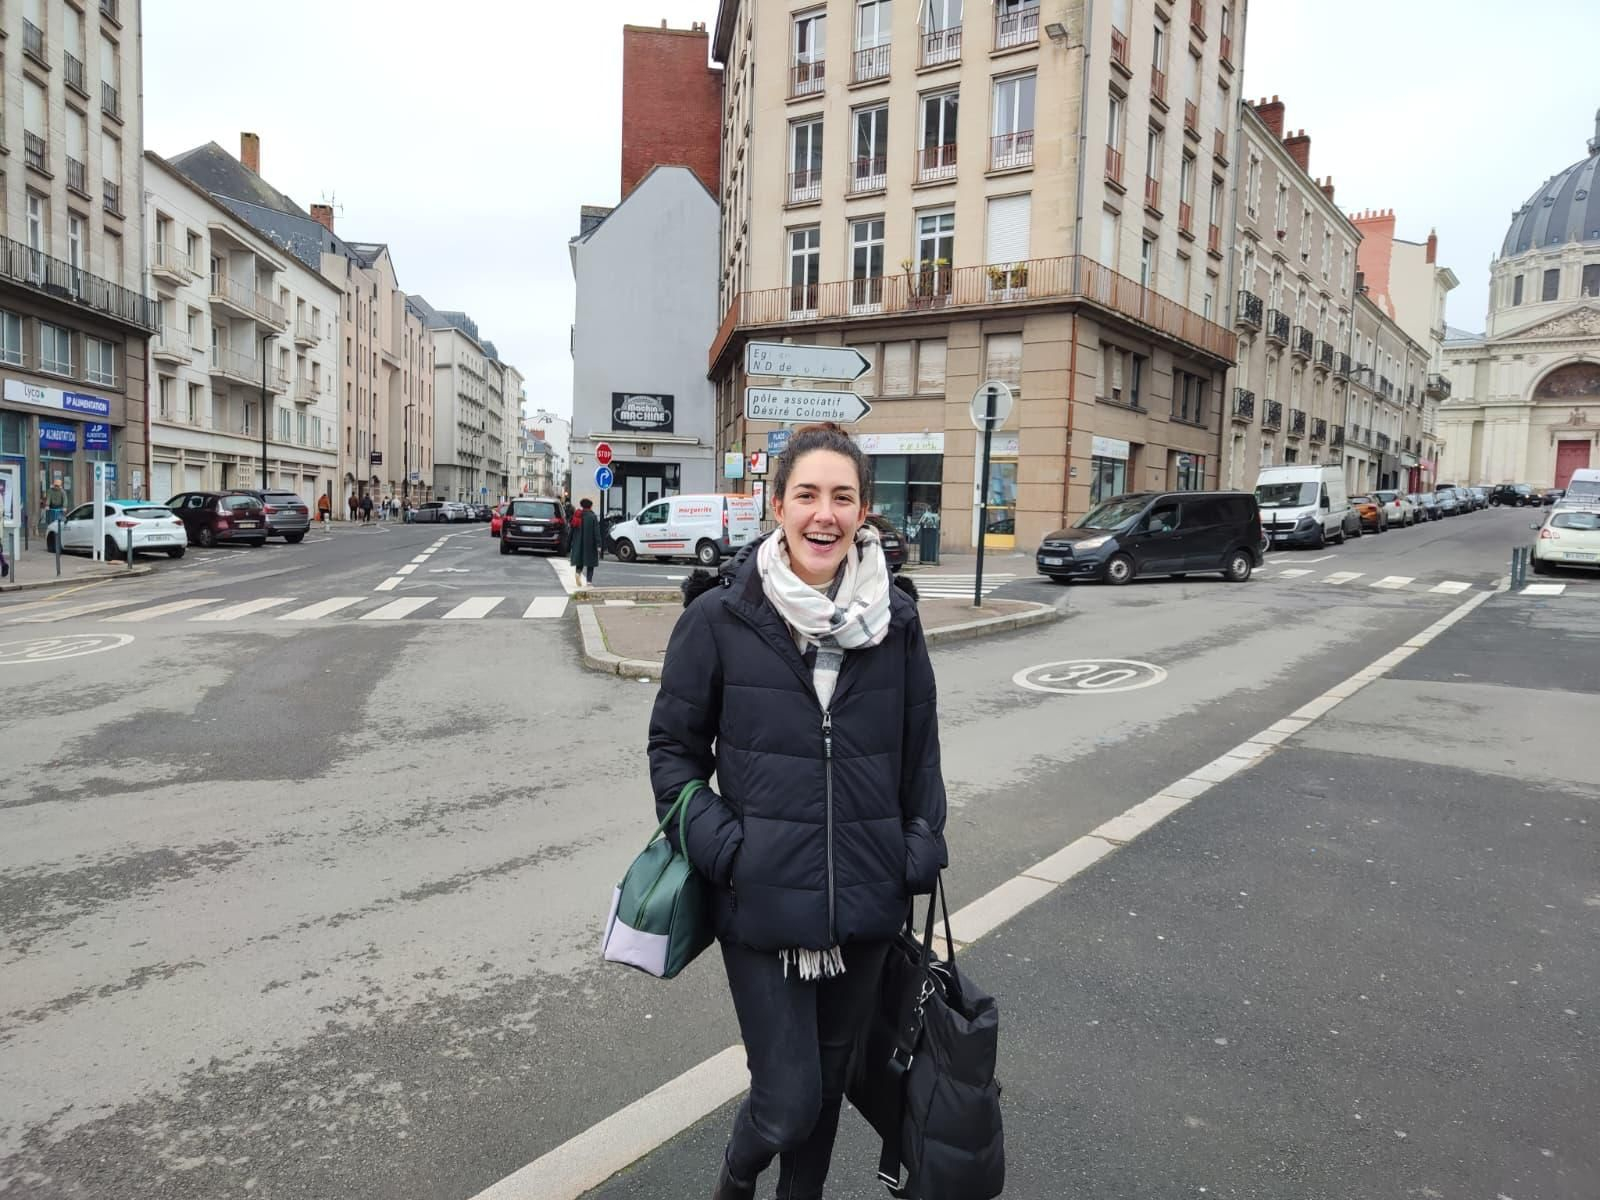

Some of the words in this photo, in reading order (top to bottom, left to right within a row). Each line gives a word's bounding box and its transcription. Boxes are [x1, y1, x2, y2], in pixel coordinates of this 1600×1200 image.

[779, 362, 792, 372] de
[72, 398, 107, 412] ALIMENTATION
[752, 393, 778, 405] pôle
[784, 396, 841, 407] associatif
[620, 411, 665, 422] MACHINE
[752, 405, 790, 416] Désiré
[796, 407, 845, 418] Colombe
[598, 450, 611, 458] STOP
[1038, 664, 1137, 689] 30
